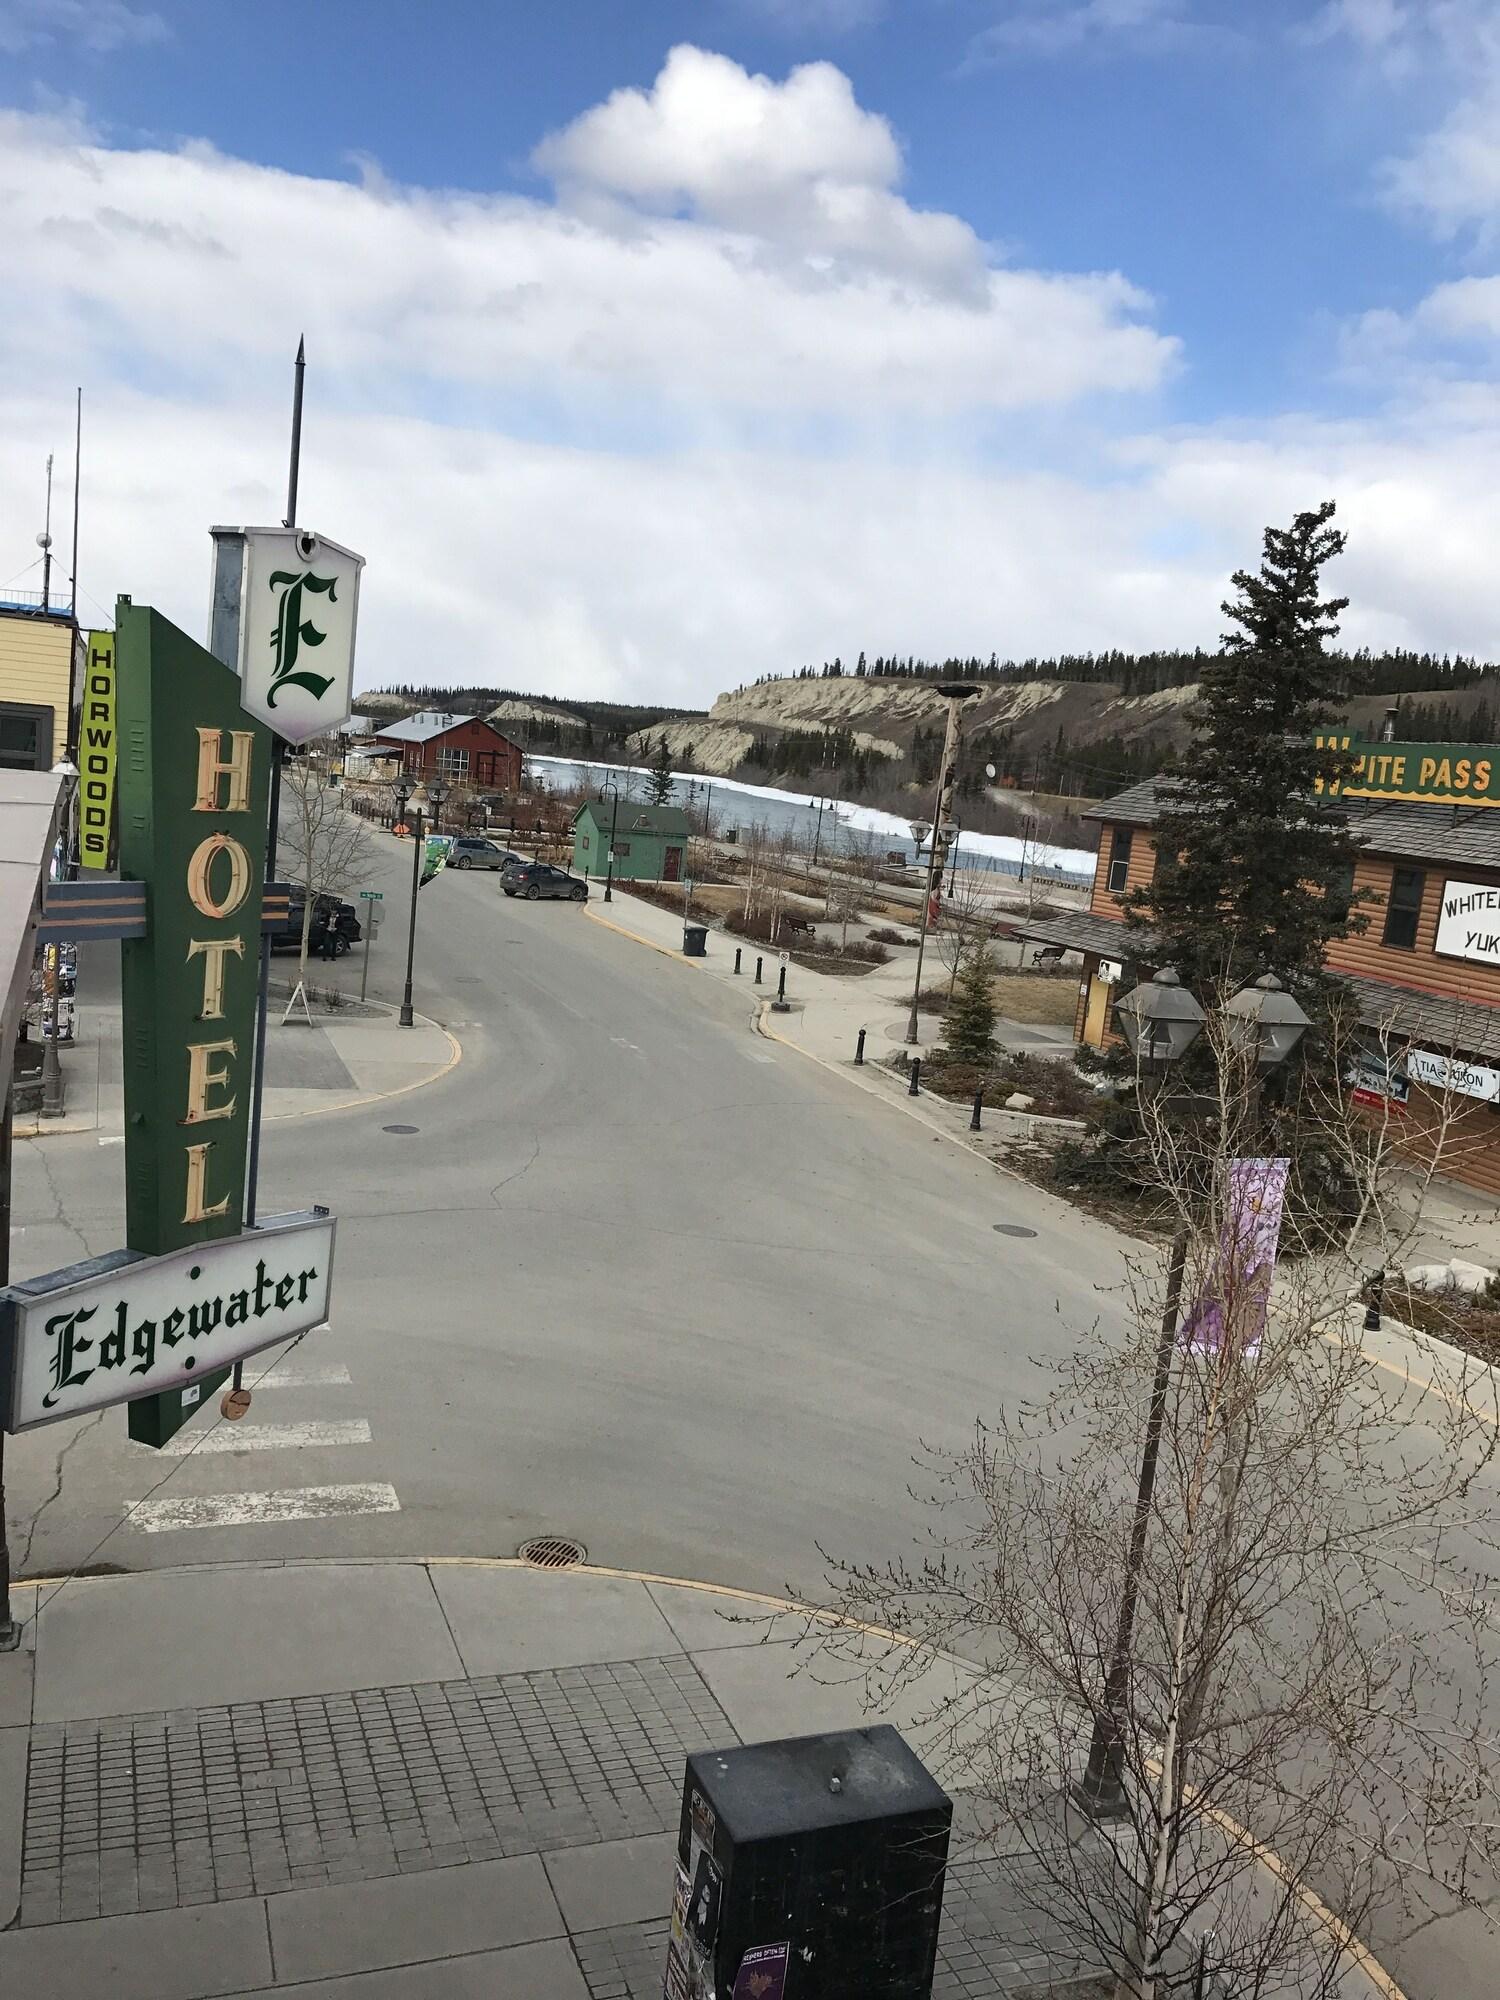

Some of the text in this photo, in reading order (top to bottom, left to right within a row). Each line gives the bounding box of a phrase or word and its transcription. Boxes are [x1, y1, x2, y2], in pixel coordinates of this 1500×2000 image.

[267, 570, 339, 709] E
[85, 647, 112, 853] HORWOODS
[1419, 757, 1491, 791] PASS
[1445, 891, 1500, 918] WHITE
[177, 727, 255, 1224] HOTEL
[1420, 1060, 1437, 1073] TIA
[43, 1259, 318, 1408] Edgewater
